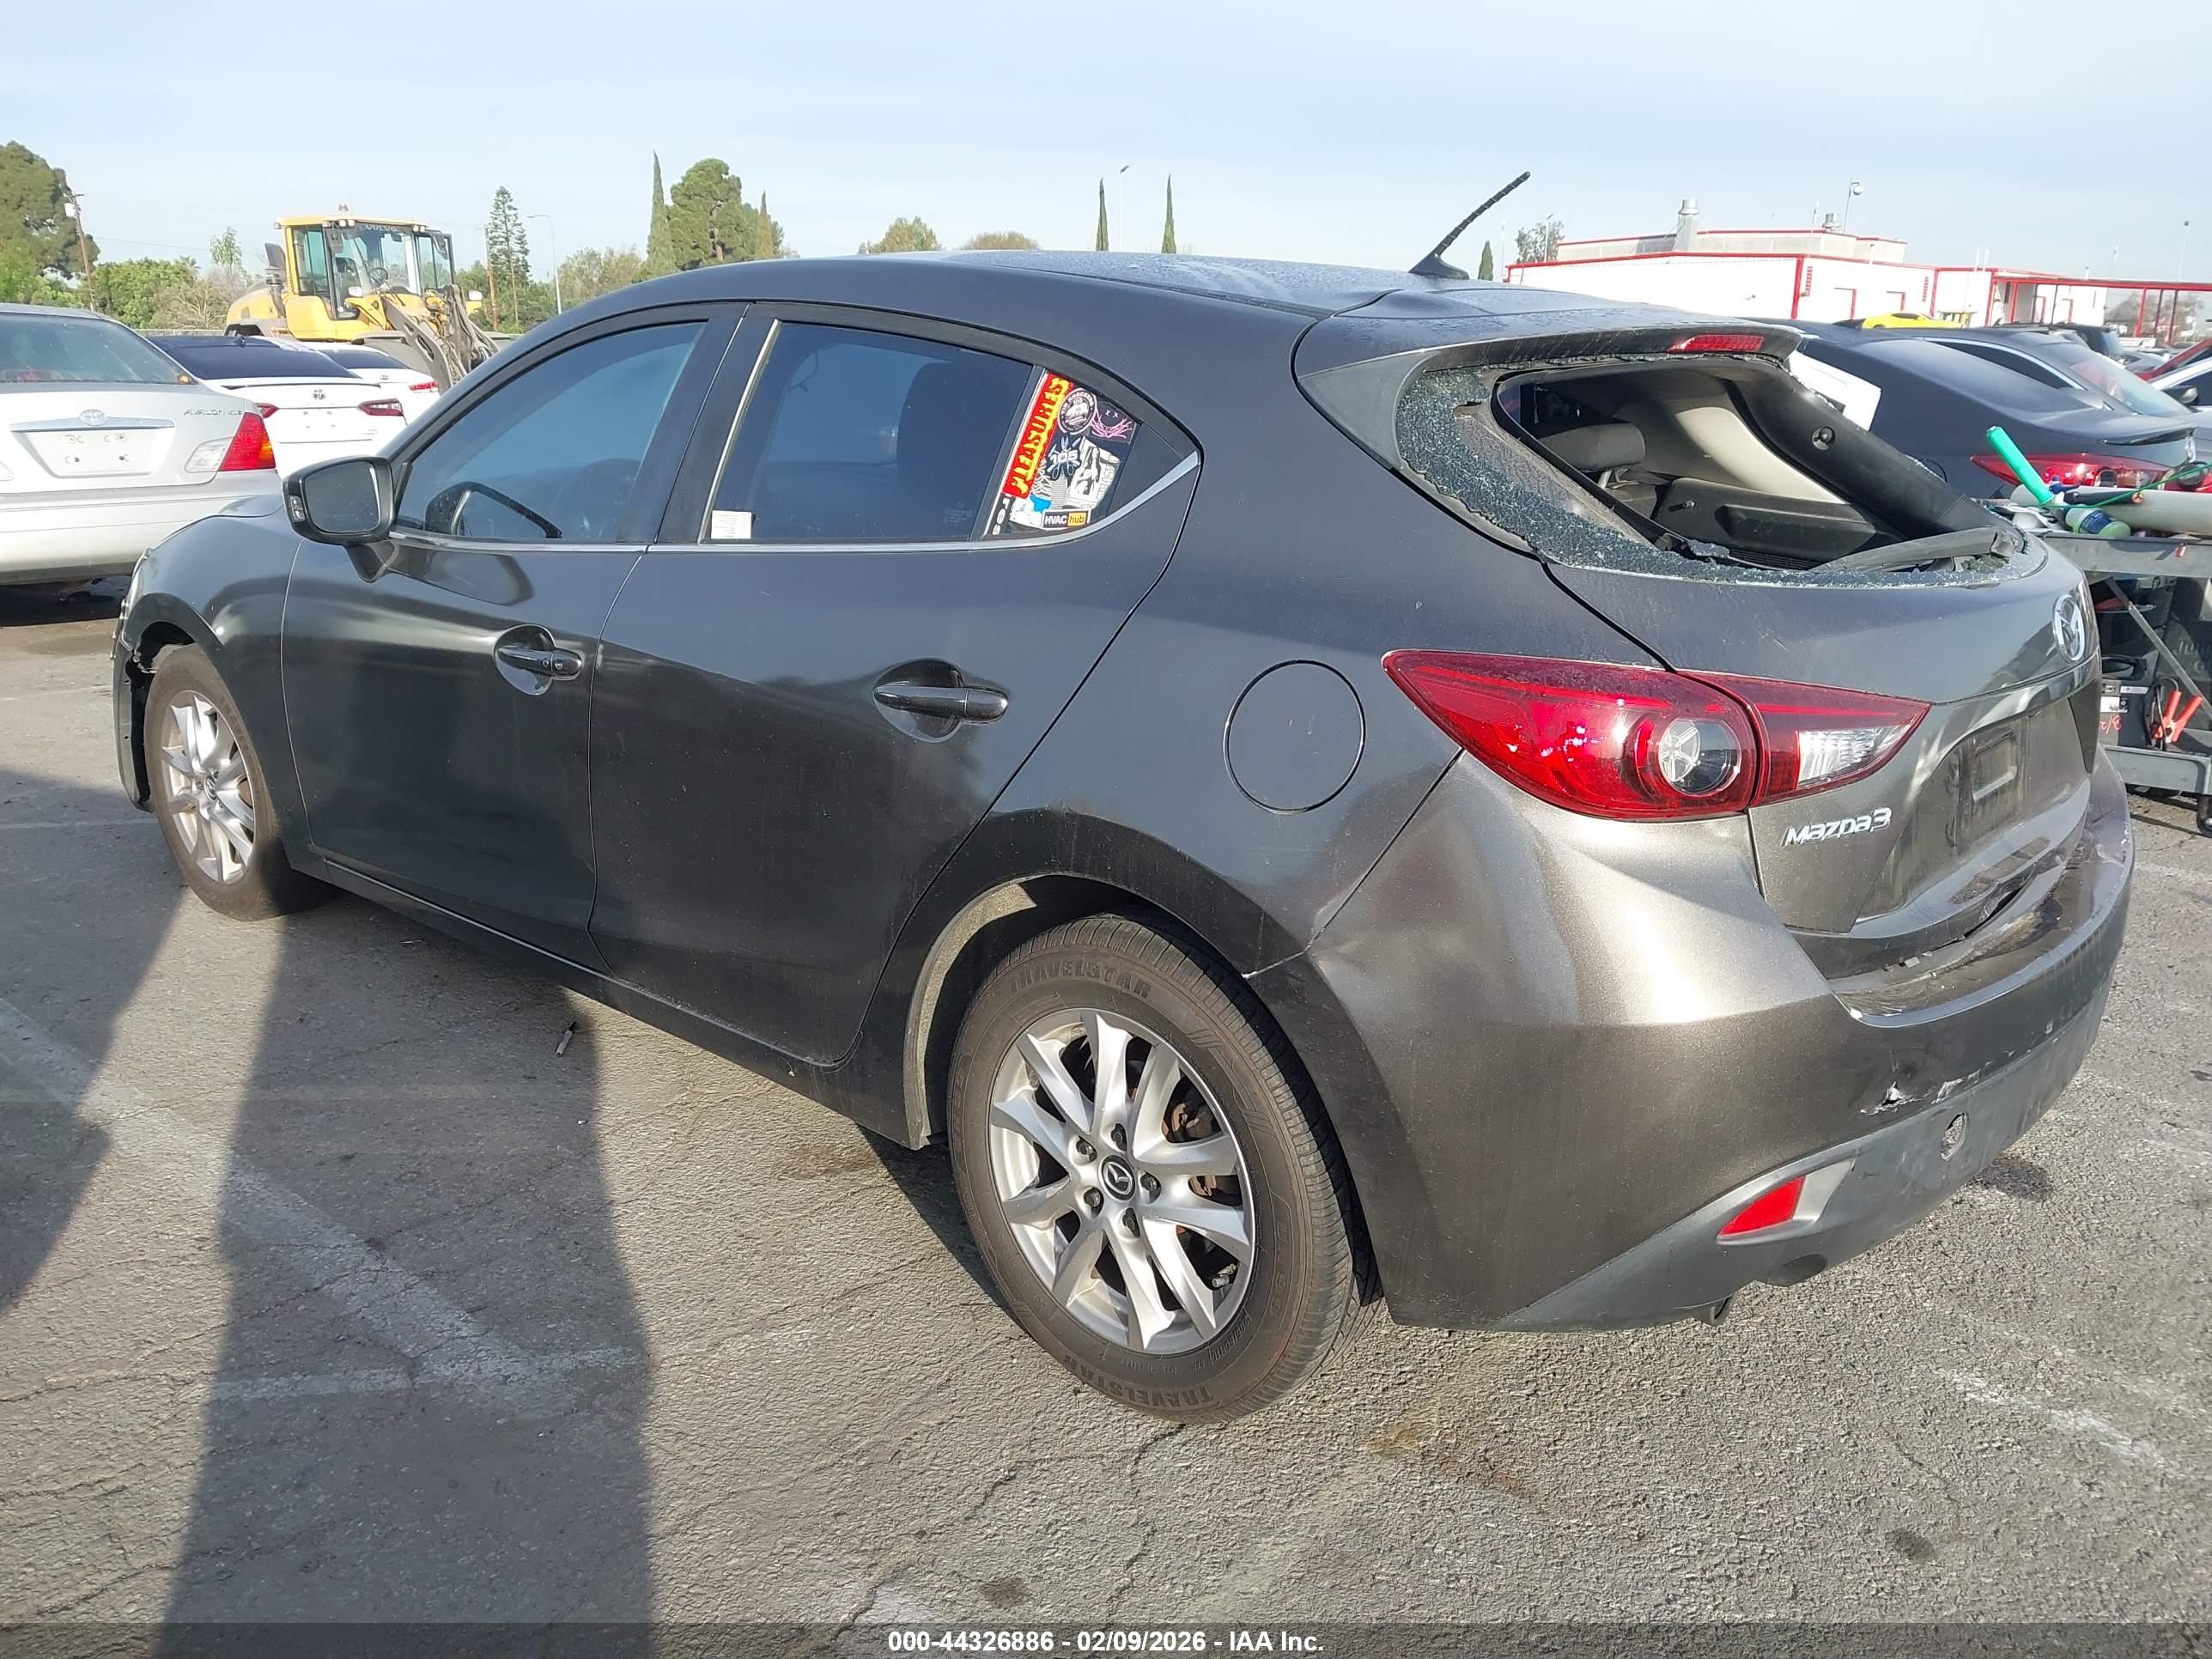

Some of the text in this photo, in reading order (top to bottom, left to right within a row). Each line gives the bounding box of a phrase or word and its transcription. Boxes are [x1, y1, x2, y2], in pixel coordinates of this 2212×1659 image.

[1048, 449, 1079, 465] 105
[1044, 514, 1085, 525] HVAC hub
[1009, 959, 1152, 999] TRAVELSTAR
[1062, 1353, 1214, 1407] TRAVELSTAR
